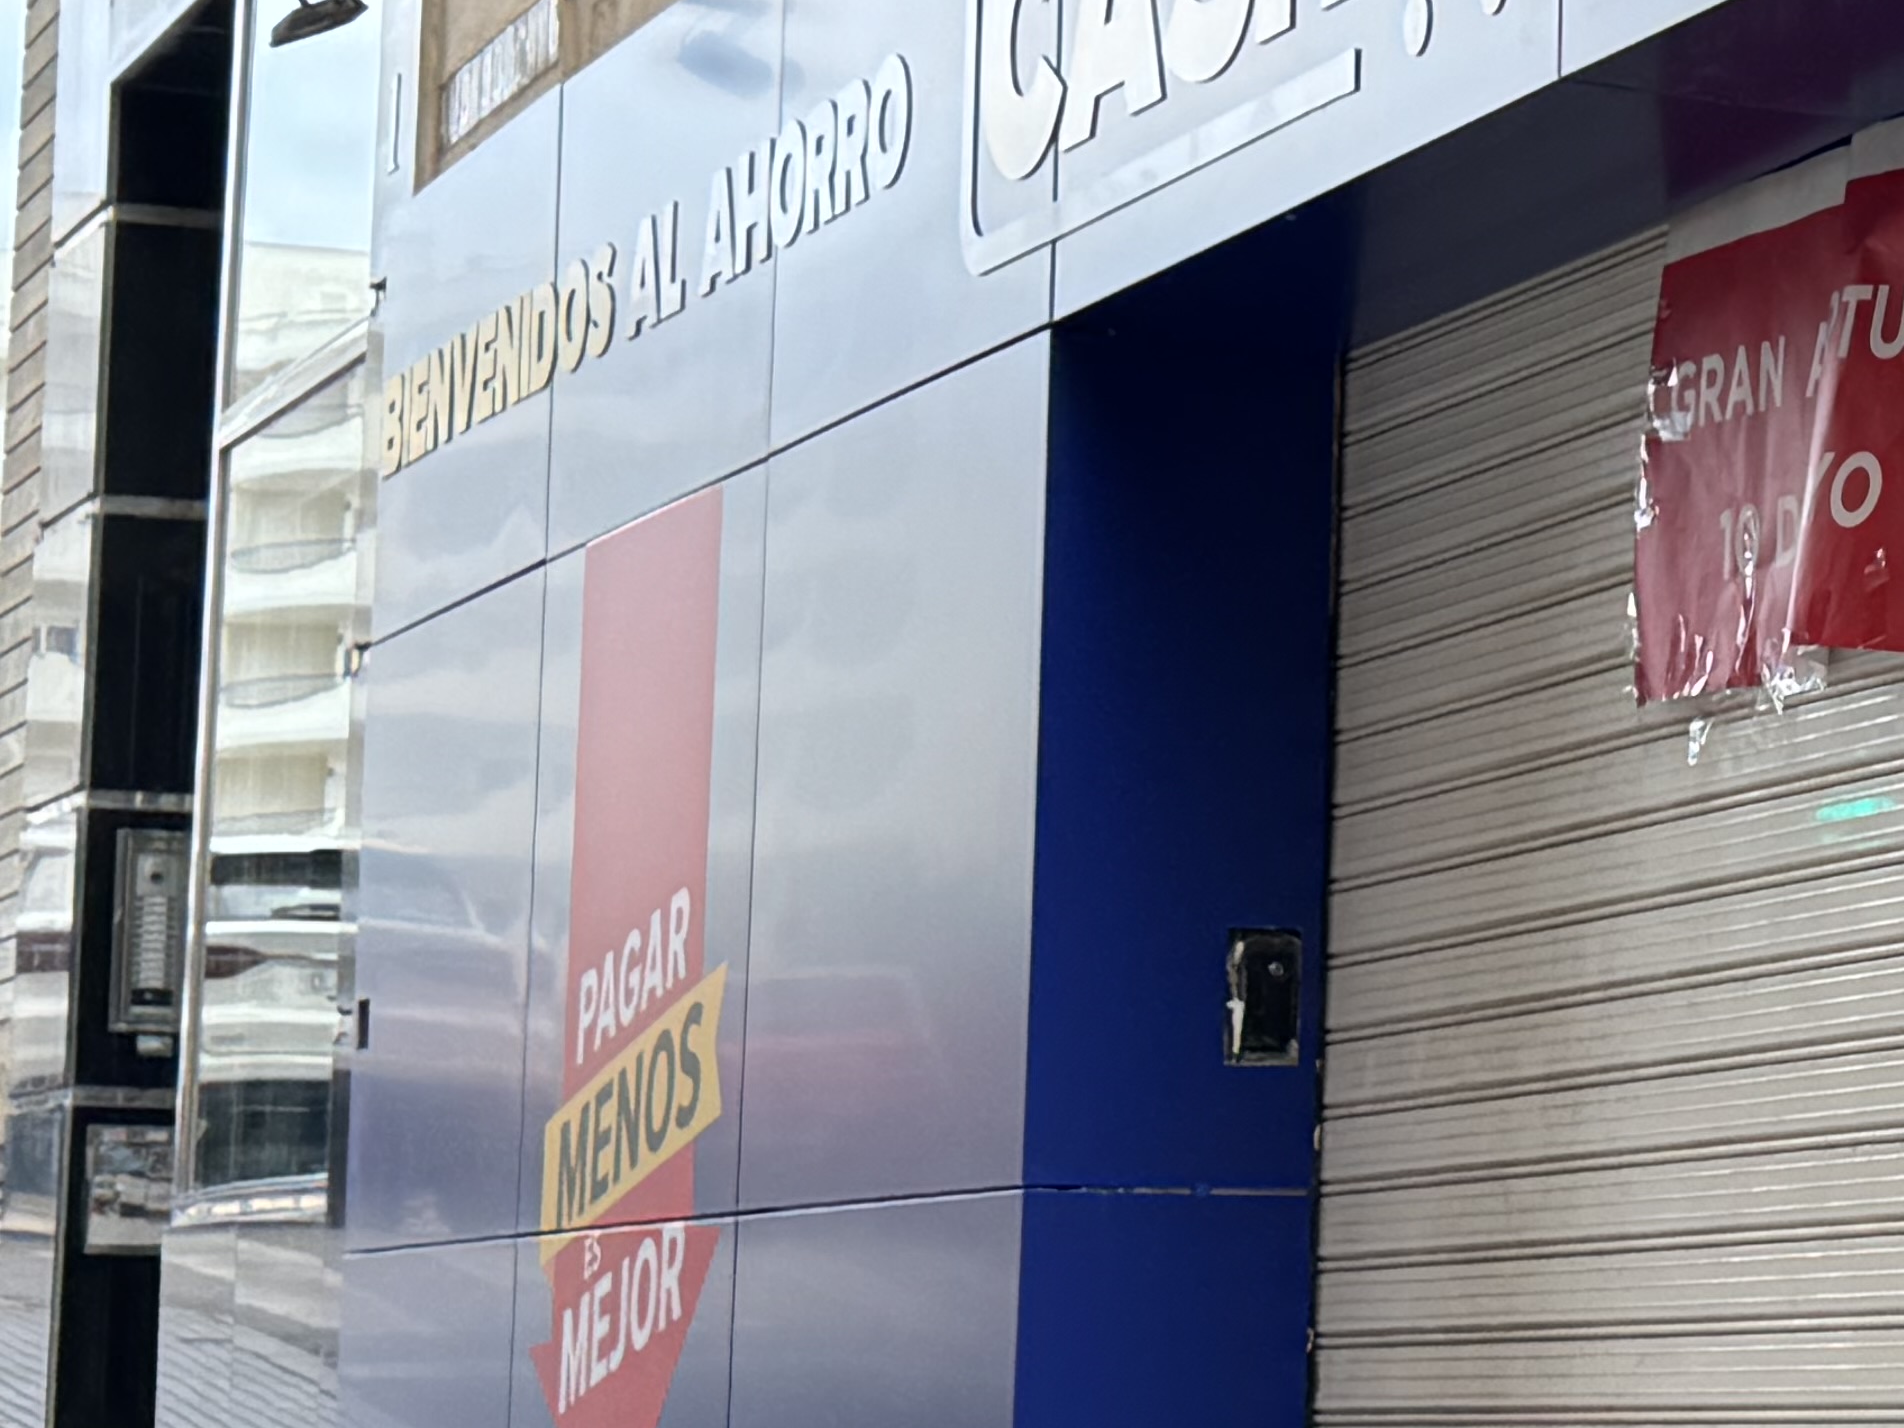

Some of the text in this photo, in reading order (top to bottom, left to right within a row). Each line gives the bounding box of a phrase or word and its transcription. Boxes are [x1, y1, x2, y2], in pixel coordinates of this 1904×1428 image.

[382, 242, 617, 481] BIENVENIDOS
[626, 201, 687, 341] AL
[699, 53, 913, 298] AHORRO
[1672, 335, 1786, 429] GRAN
[576, 886, 690, 1065] PAGAR
[555, 1001, 704, 1230] MENOS
[558, 1222, 685, 1415] MEJOR
